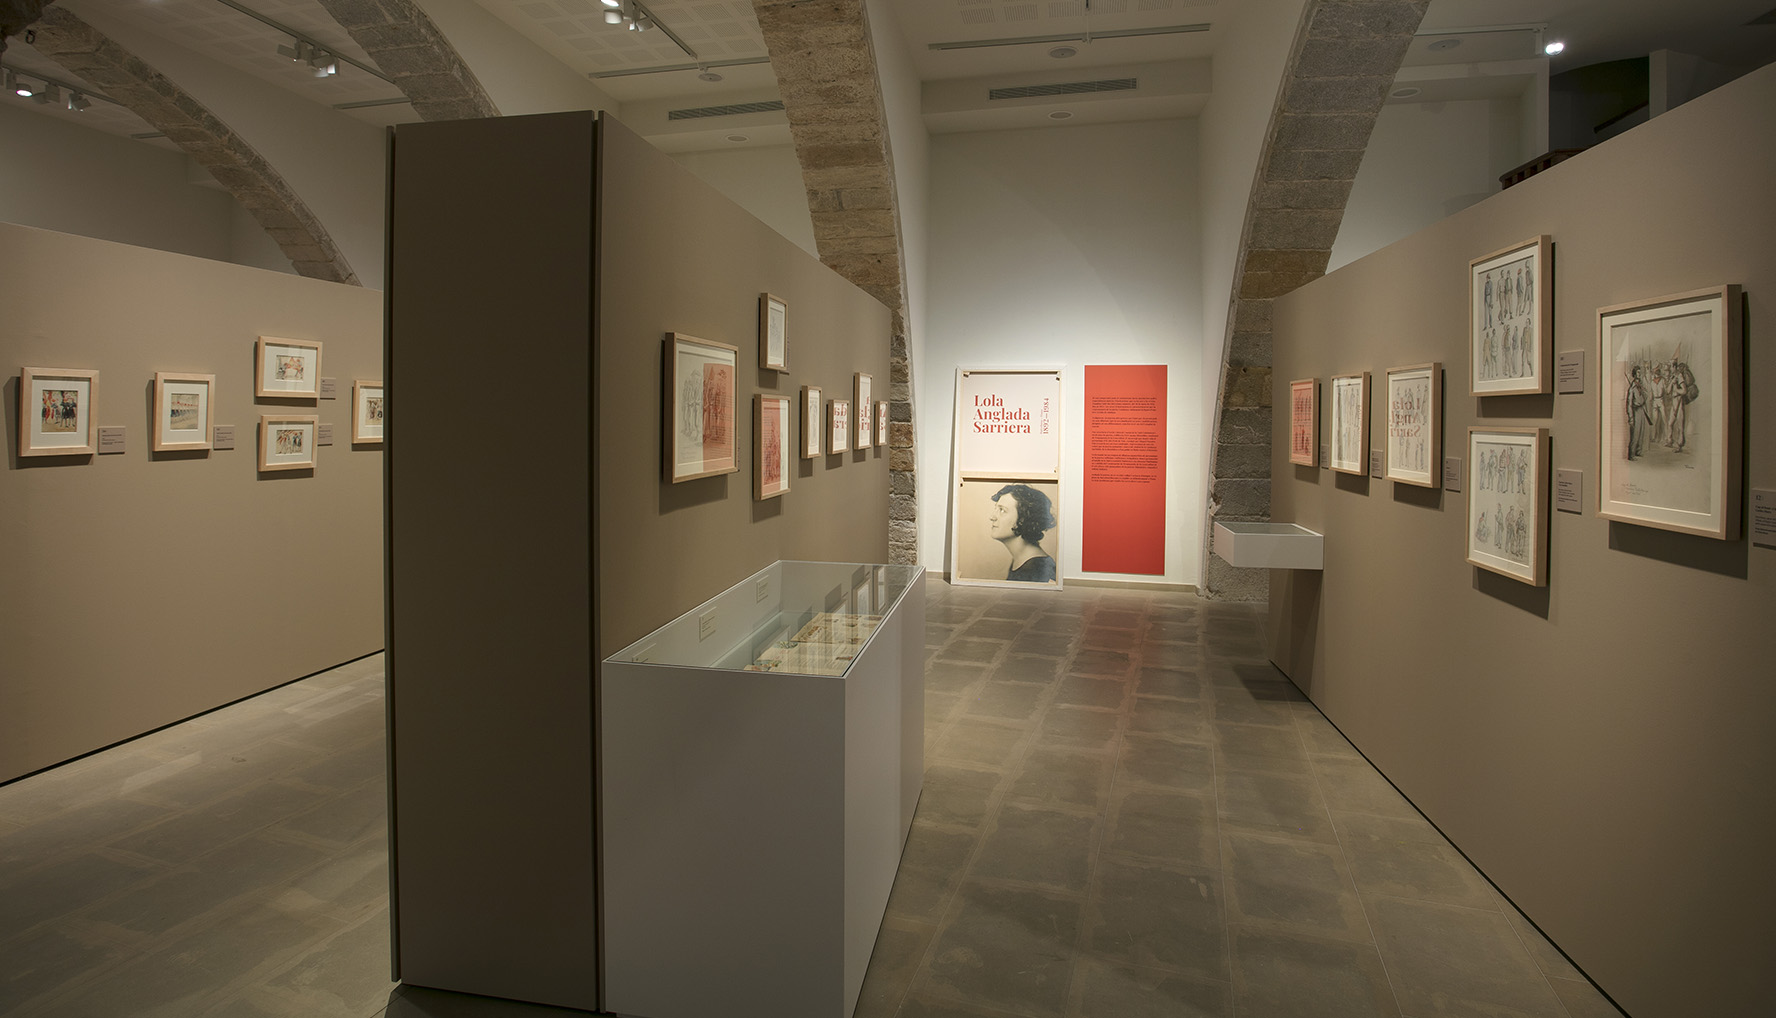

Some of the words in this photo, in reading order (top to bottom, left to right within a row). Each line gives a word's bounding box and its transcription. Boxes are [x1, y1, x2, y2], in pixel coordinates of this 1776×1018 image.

[974, 394, 1003, 407] Lola
[973, 408, 1030, 422] Anglada
[973, 421, 1031, 434] Sarriera
